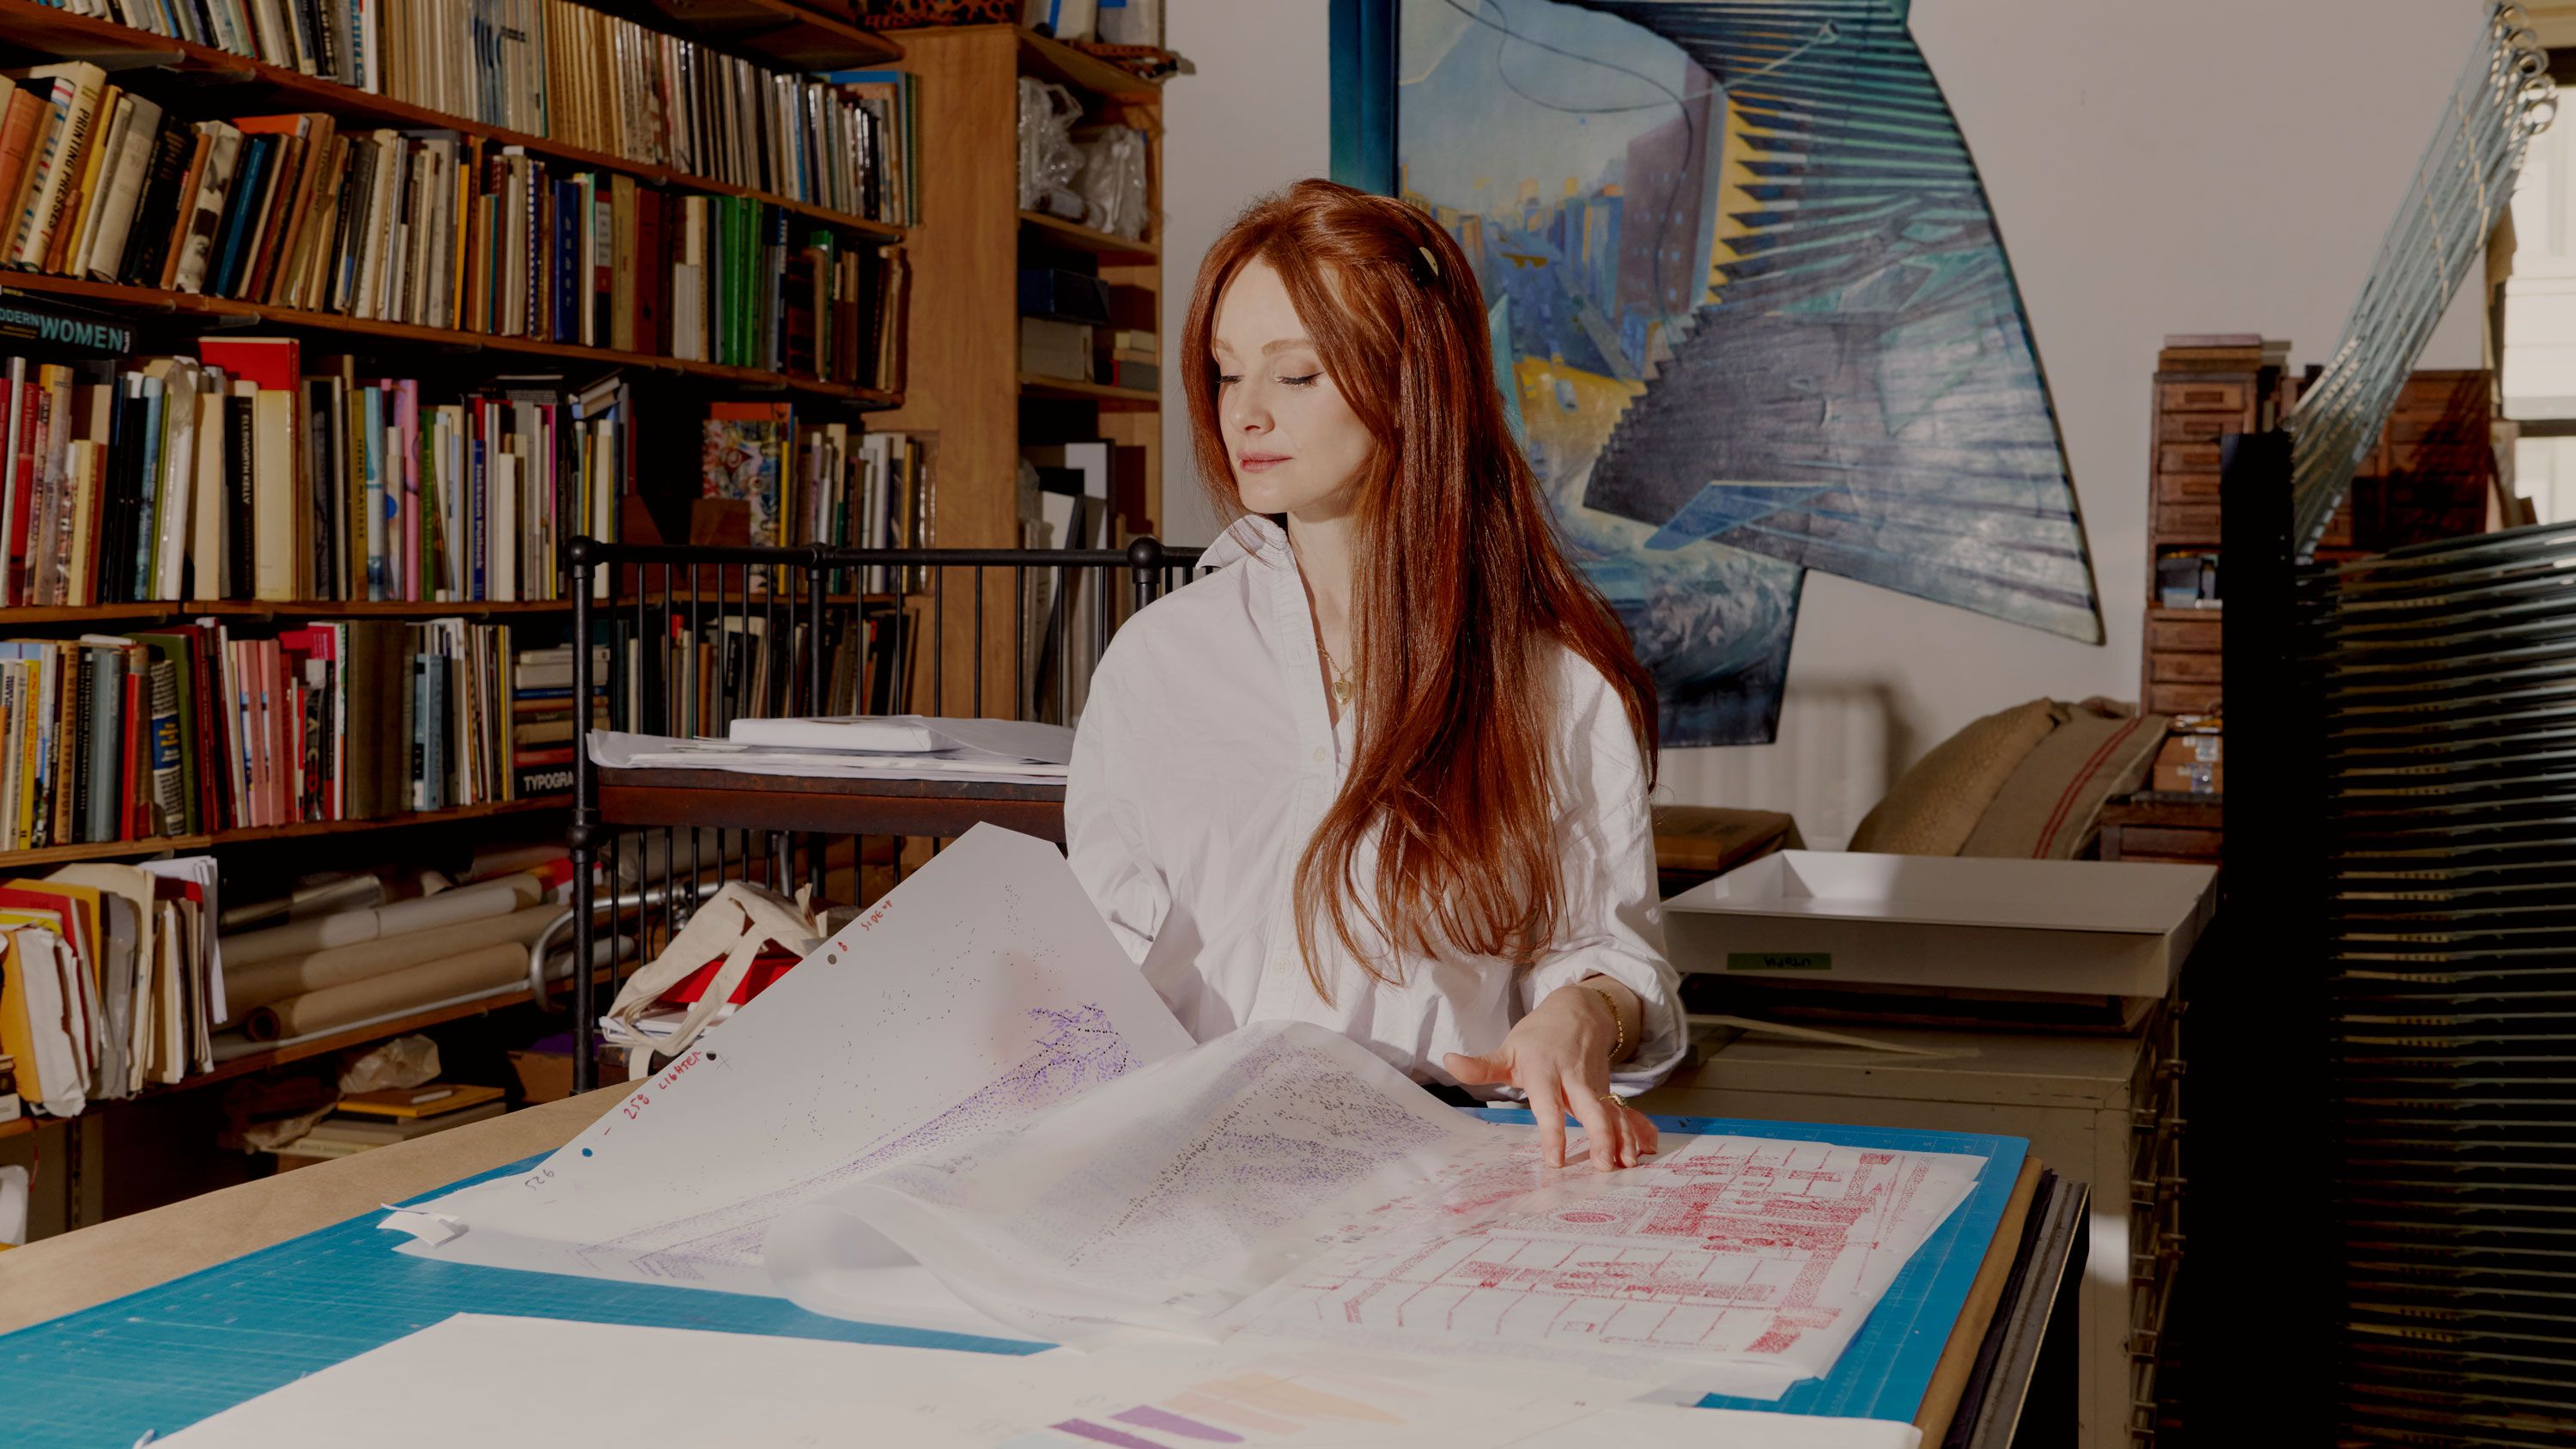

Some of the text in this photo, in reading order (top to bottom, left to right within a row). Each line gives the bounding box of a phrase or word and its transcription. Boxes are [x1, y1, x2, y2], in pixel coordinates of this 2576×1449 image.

[64, 107, 91, 172] PRINTING
[48, 171, 71, 229] PRESSES
[40, 316, 124, 352] WOMEN
[241, 414, 251, 474] ELLSWORTH
[242, 474, 251, 506] KELLY
[422, 449, 432, 514] Elizabeth
[475, 463, 483, 569] Jackson Pollock
[62, 648, 78, 817] THE WESTERN TYPE BOOK
